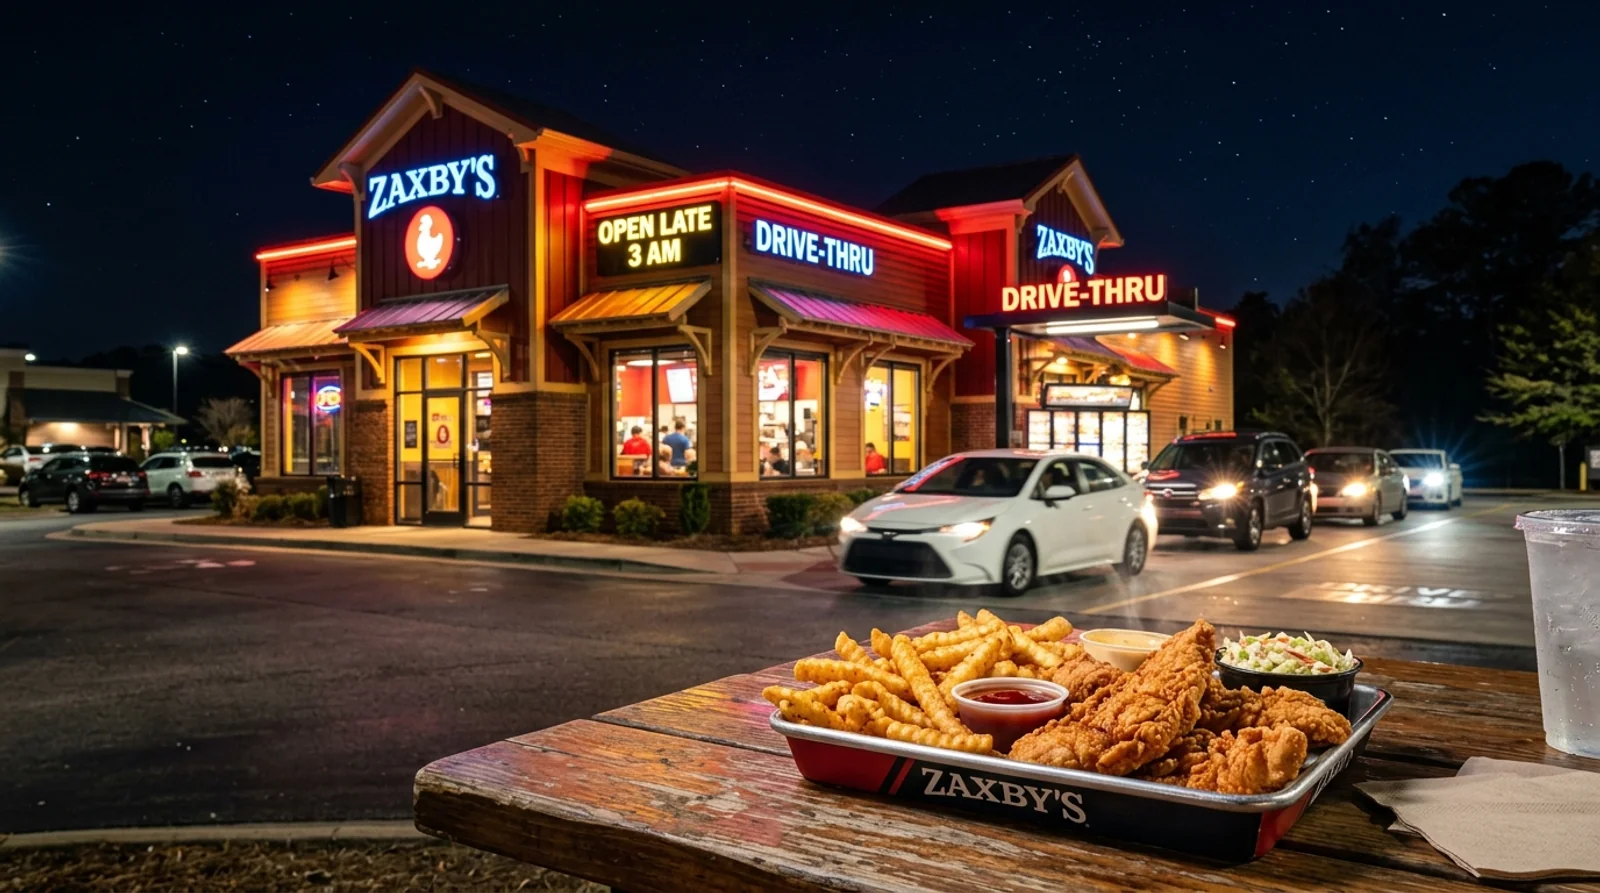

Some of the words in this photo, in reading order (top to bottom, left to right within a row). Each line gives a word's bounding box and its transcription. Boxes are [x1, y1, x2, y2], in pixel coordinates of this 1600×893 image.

[368, 154, 496, 219] ZAXBY'S
[598, 214, 655, 245] OPEN
[660, 205, 712, 236] LATE
[756, 219, 874, 276] DRIVE-THRU
[628, 243, 642, 267] 3
[647, 238, 681, 265] AM
[1002, 274, 1165, 312] DRIVE-THRU
[921, 767, 1087, 824] ZAXBY'S
